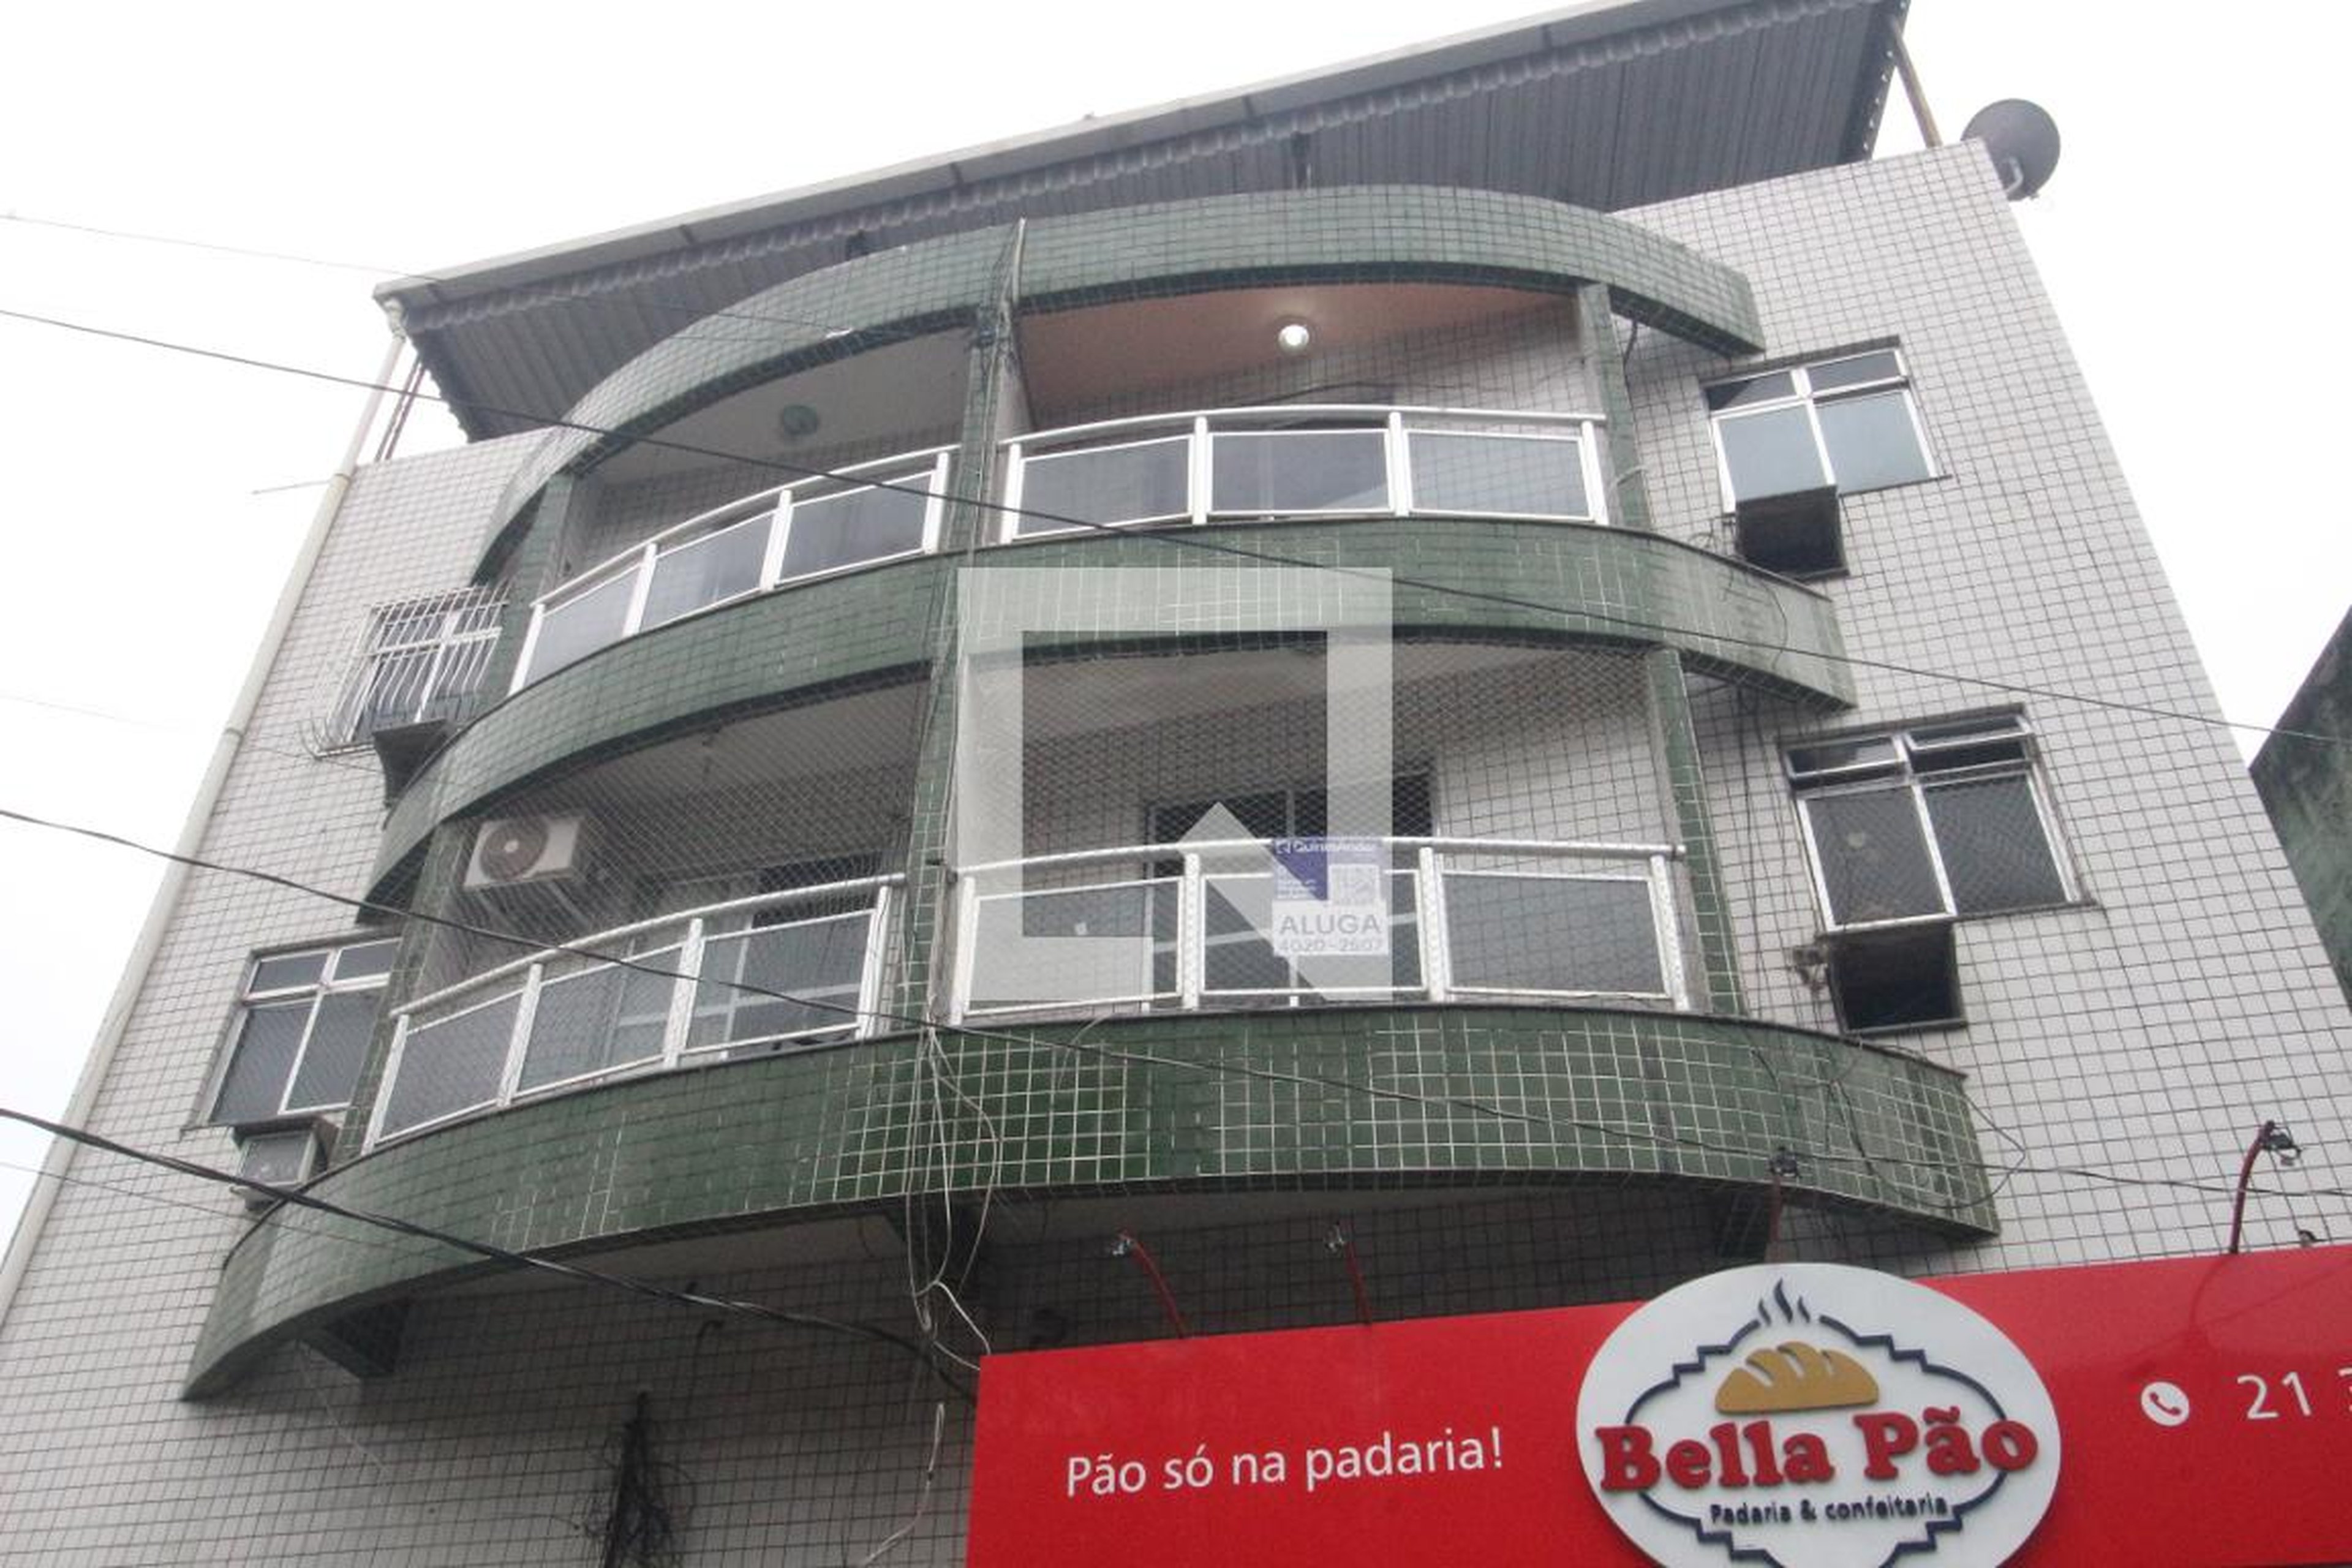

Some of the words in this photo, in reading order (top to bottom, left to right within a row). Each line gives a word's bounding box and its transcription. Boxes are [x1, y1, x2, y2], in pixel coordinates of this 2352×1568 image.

[1280, 914, 1382, 935] ALUGA
[2237, 1371, 2312, 1420] 21
[1067, 1453, 1147, 1498] Pão
[1163, 1444, 1214, 1490] só
[1232, 1450, 1286, 1485] na
[1305, 1426, 1504, 1492] padaria!
[1594, 1419, 1836, 1493] Bella
[1853, 1404, 2039, 1482] Pão
[1709, 1501, 1792, 1526] Padaria
[1800, 1499, 1817, 1521] &
[1825, 1494, 1949, 1520] confeitaria
